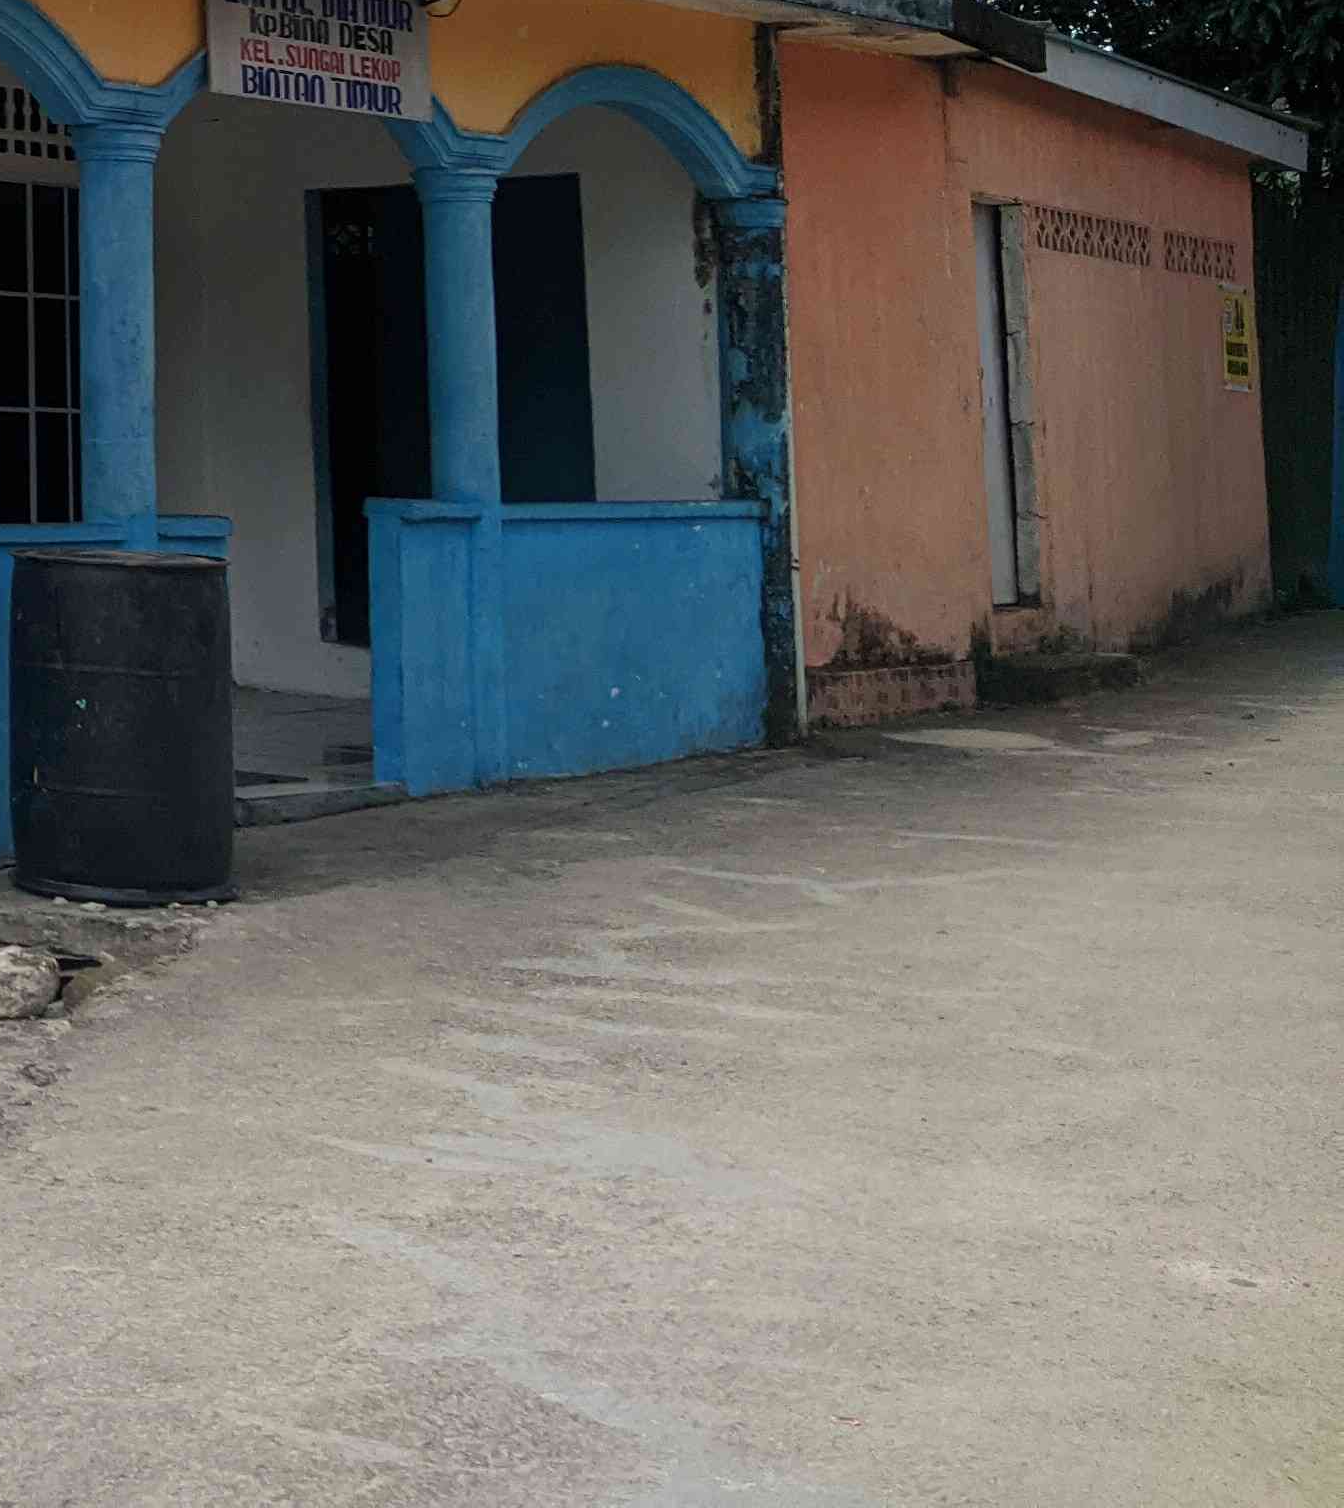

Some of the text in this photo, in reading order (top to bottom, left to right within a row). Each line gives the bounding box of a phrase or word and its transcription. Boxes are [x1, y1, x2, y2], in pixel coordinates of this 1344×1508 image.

[340, 25, 393, 55] DESA
[350, 55, 401, 83] LEKOP
[332, 77, 402, 115] TIMUR
